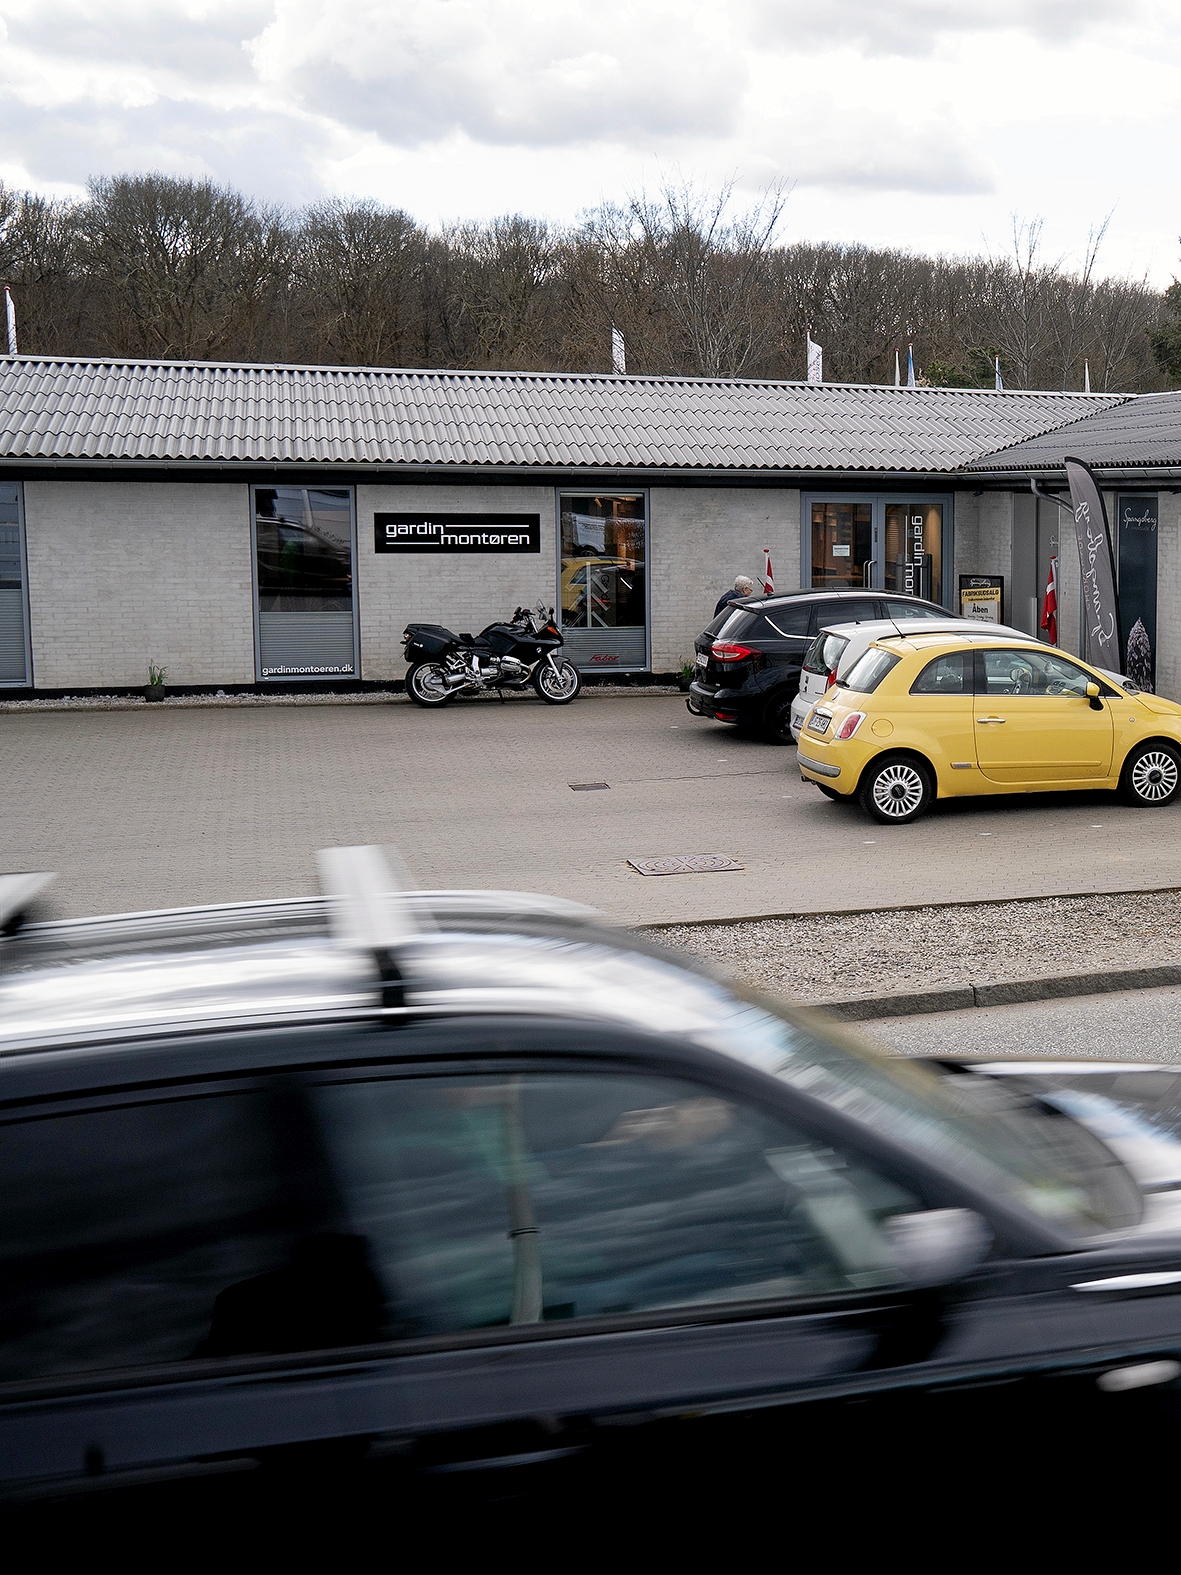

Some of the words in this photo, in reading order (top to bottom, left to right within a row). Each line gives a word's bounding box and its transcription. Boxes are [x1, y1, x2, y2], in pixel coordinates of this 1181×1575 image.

[1122, 507, 1158, 531] Spangsberg
[386, 522, 444, 537] gardin
[441, 532, 530, 545] montøren
[911, 515, 925, 566] gardin
[972, 603, 988, 613] Åben
[589, 653, 619, 661] Faber
[262, 664, 353, 676] gardinmontoeren.dk
